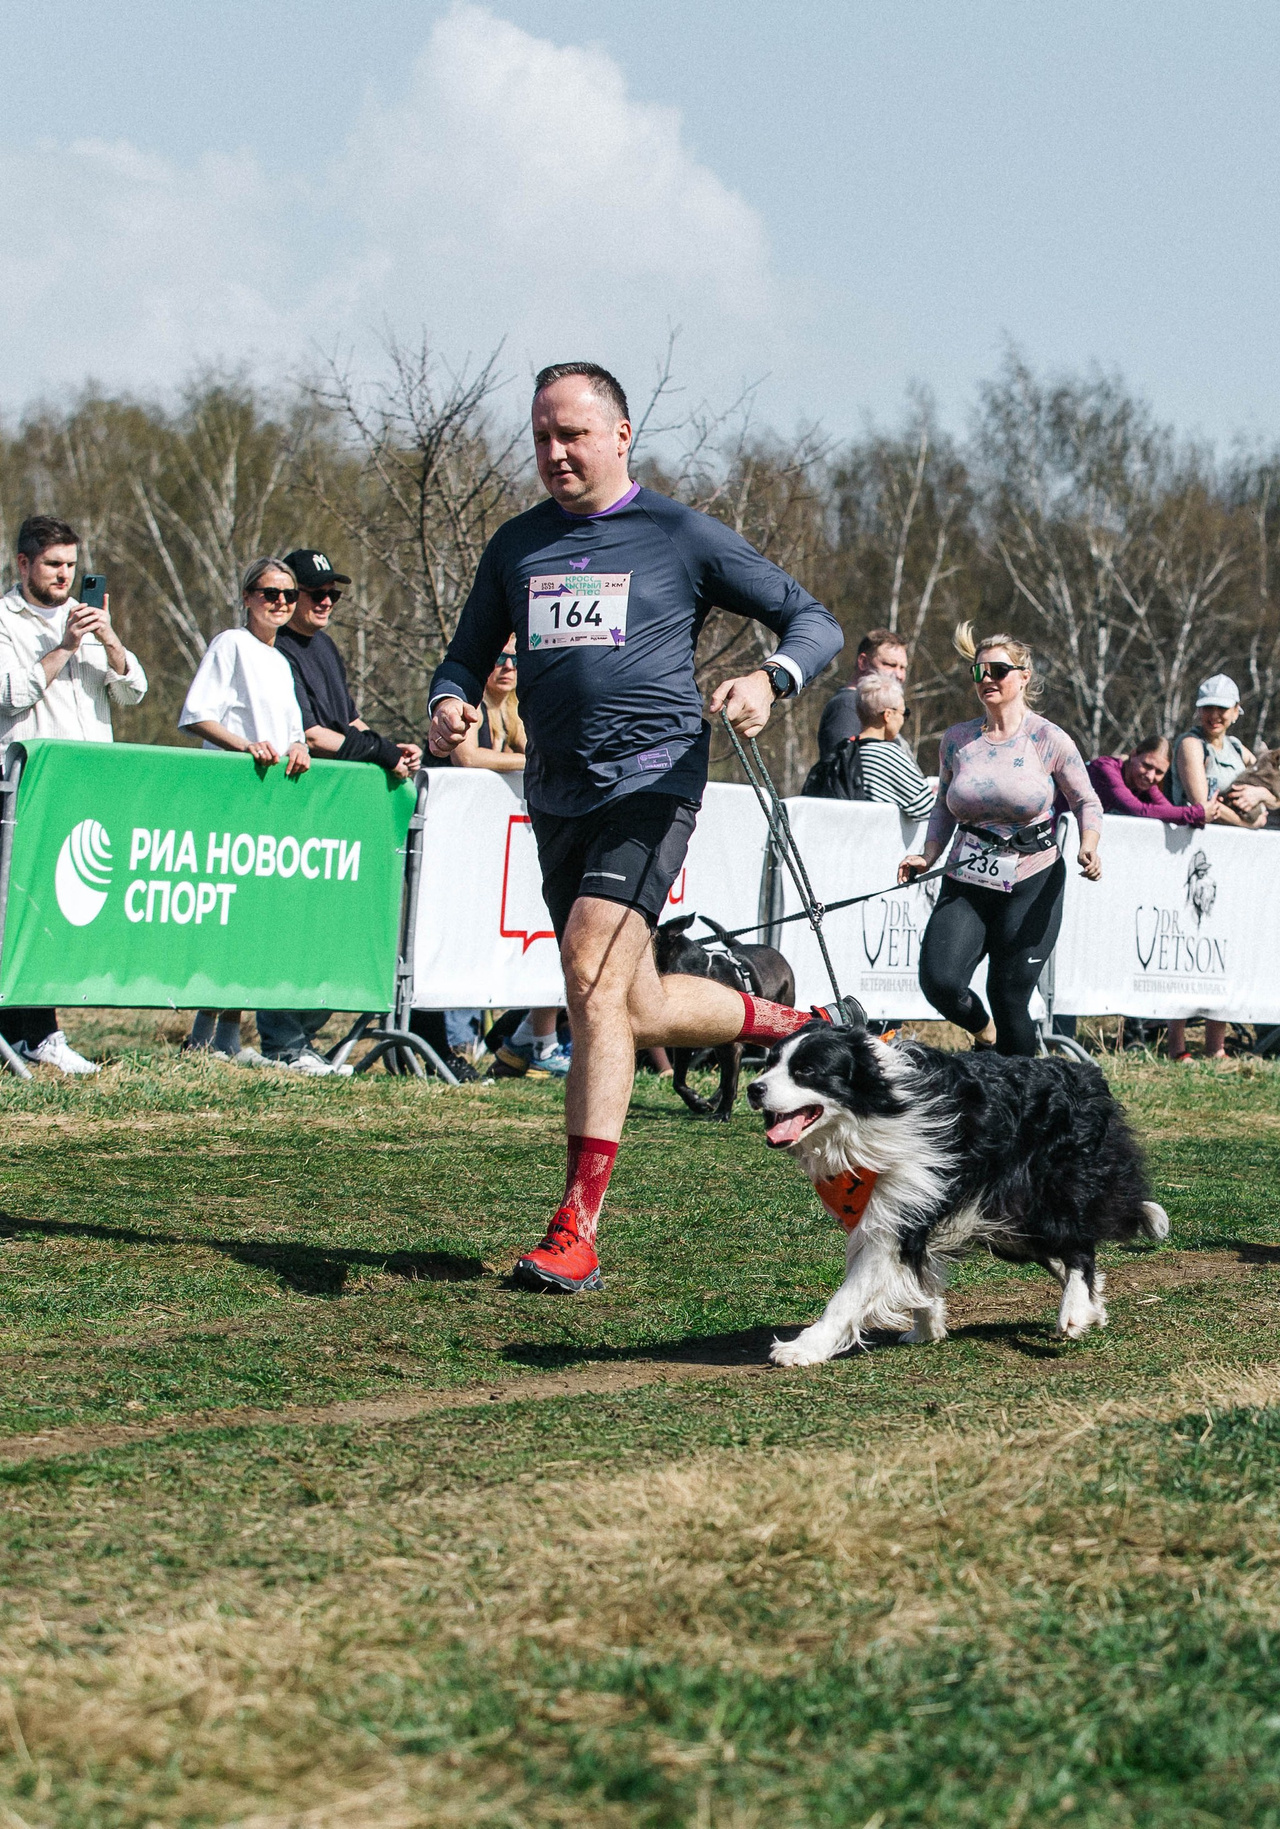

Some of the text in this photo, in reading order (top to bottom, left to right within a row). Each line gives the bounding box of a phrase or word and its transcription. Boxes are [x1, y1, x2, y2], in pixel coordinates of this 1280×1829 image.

[550, 601, 602, 629] 164
[129, 828, 362, 882] РИА НОВОСТИ
[967, 853, 999, 876] 236
[124, 879, 237, 925] СПОРТ
[890, 901, 916, 927] DR.
[1160, 909, 1184, 934] DR.
